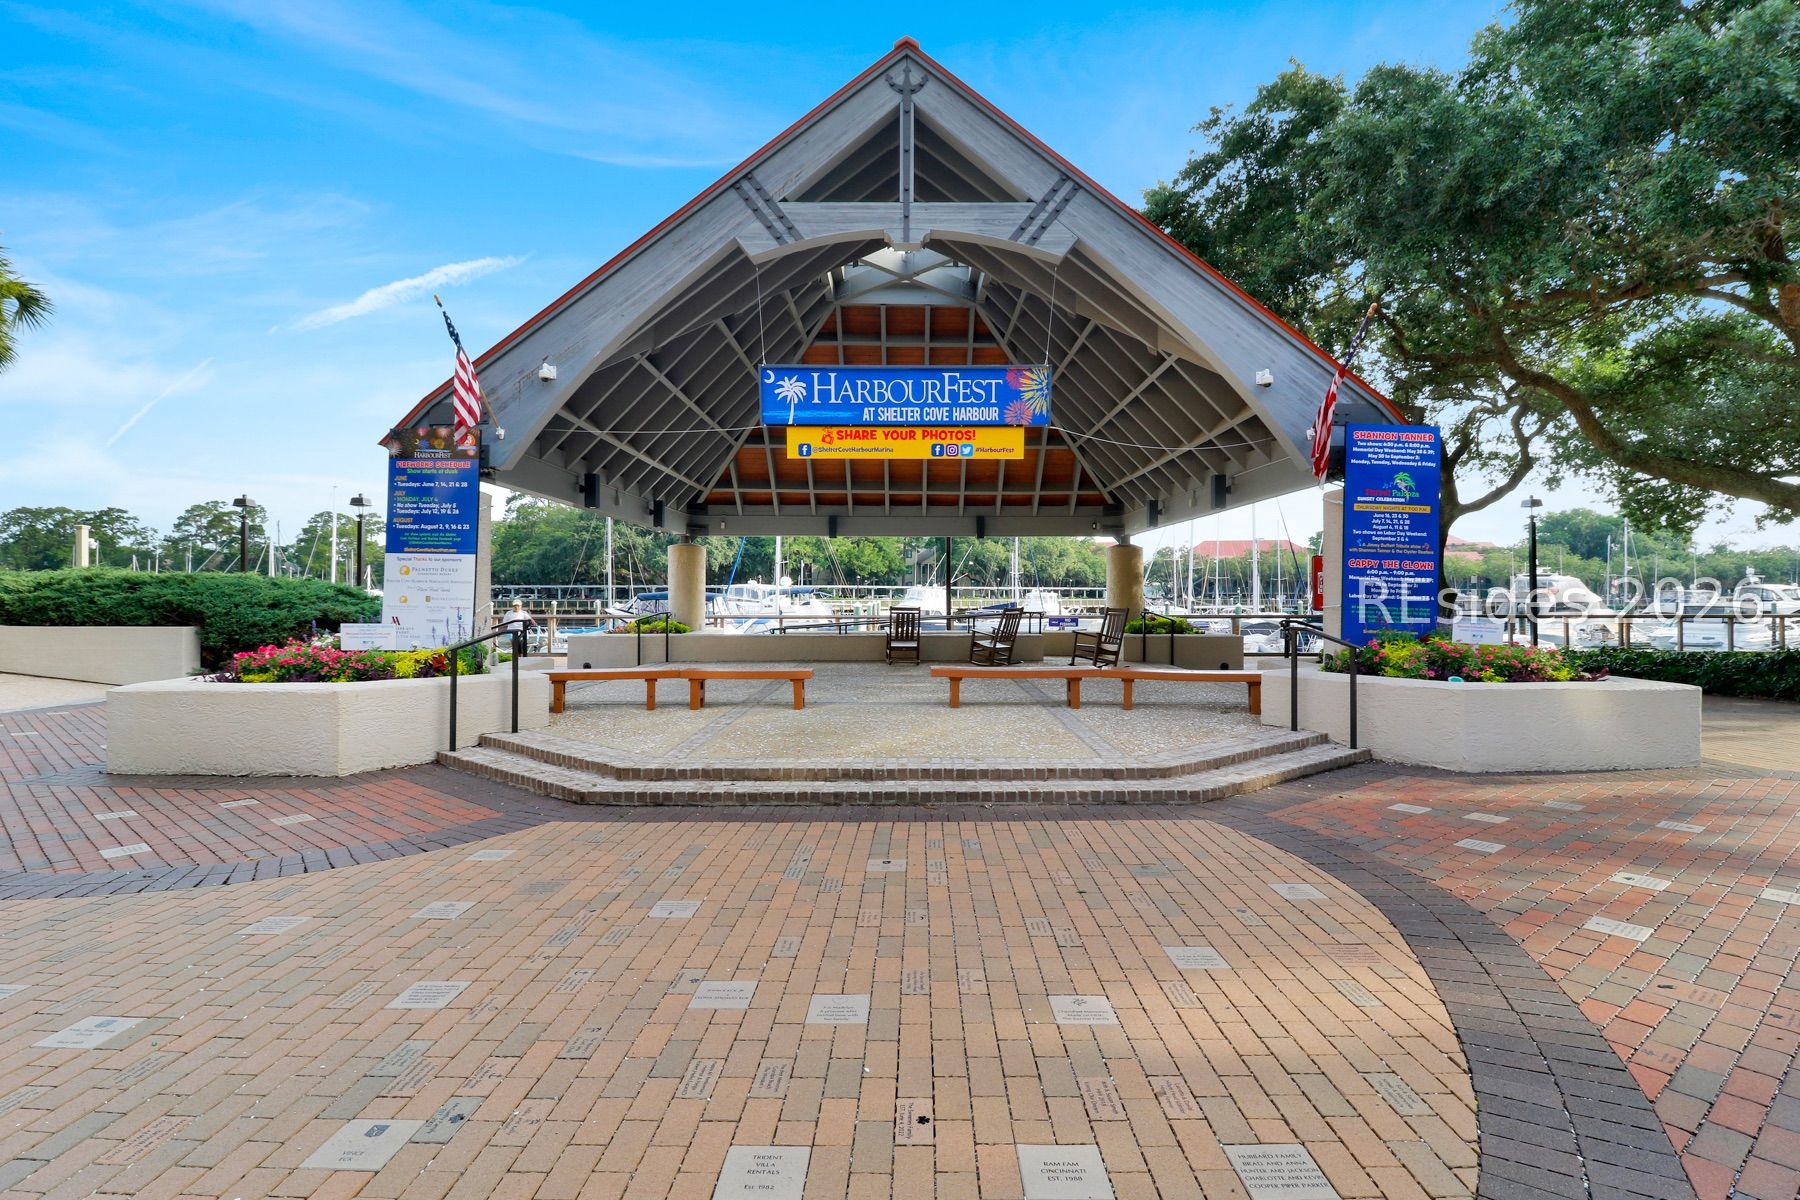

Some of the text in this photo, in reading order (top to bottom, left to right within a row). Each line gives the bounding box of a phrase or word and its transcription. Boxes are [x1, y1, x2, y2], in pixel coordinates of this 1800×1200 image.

[863, 407, 998, 421] AT SHELTER COVE HARBOUR
[836, 430, 976, 441] SHARE YOUR PHOTOS!
[1354, 431, 1434, 442] SHANNON TANNER
[1348, 559, 1434, 570] CAPPY THE CLOWN
